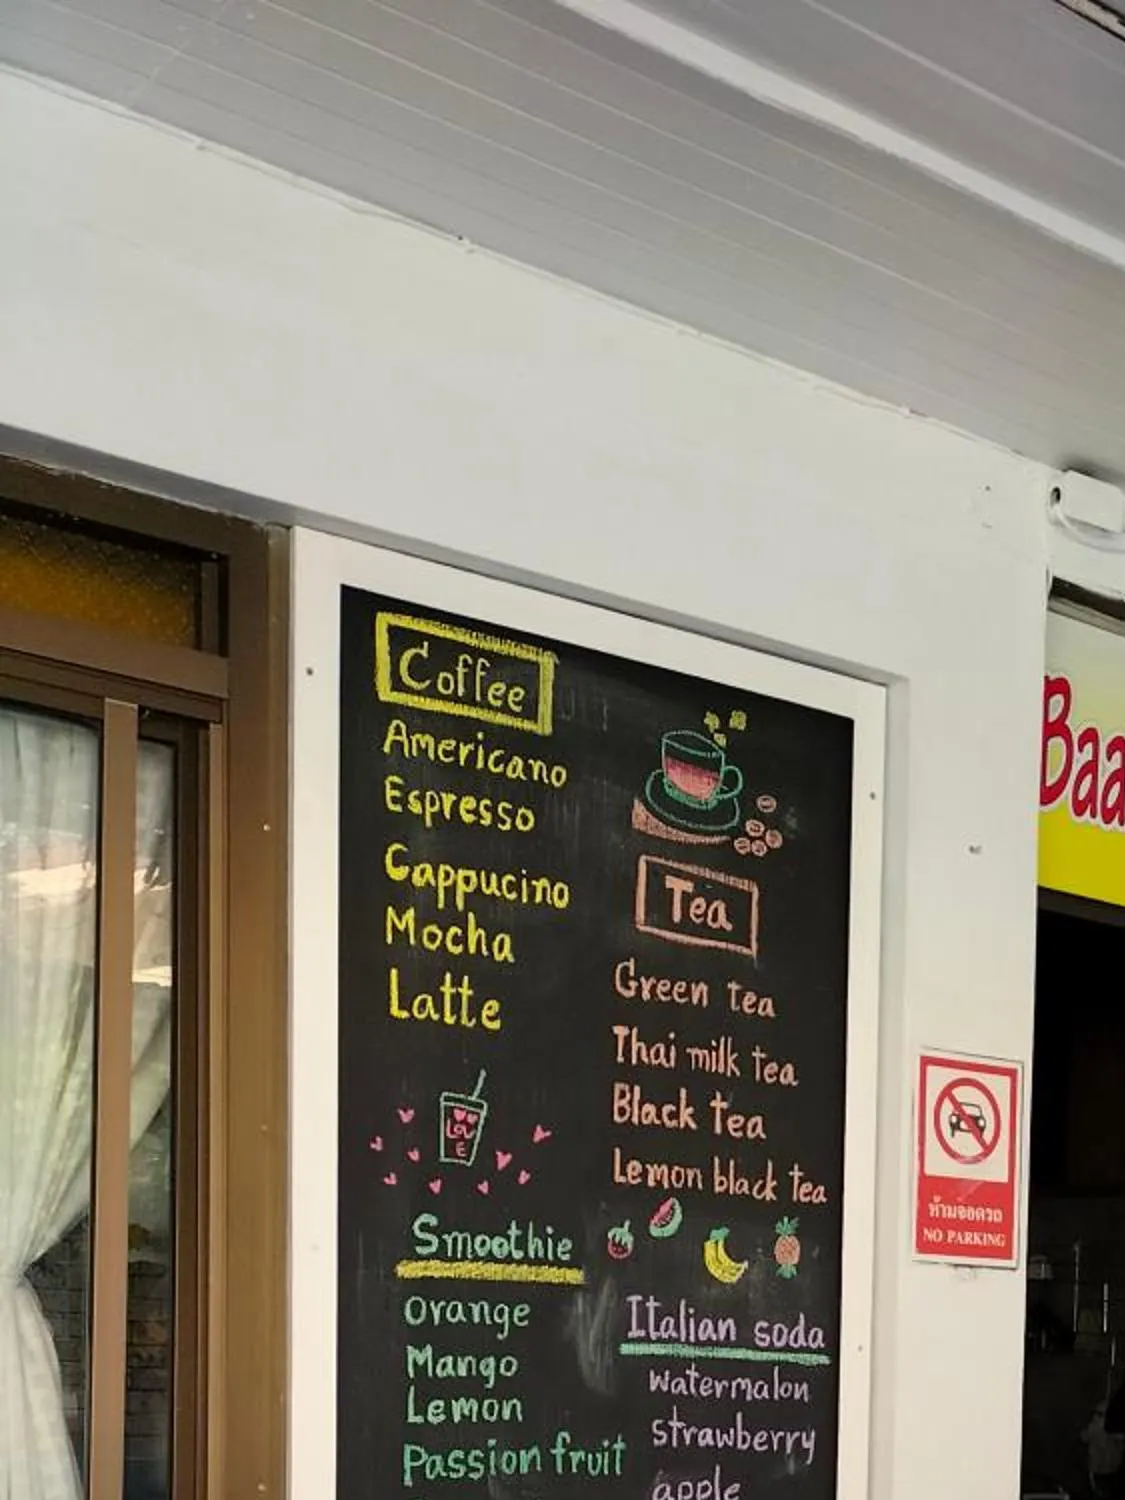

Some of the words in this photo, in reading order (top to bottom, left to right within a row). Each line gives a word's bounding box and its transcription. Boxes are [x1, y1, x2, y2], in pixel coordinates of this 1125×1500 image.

[400, 641, 526, 713] Coffee
[383, 718, 568, 788] Americano
[384, 776, 536, 833] Espresso
[385, 842, 570, 909] Cappucino
[665, 874, 733, 933] Tea
[385, 905, 515, 964] Mocha
[389, 967, 501, 1031] Latte
[613, 958, 709, 1008] Green
[727, 980, 776, 1018] tea
[613, 1025, 676, 1070] Thai
[686, 1037, 740, 1078] milk
[751, 1044, 798, 1086] tea
[611, 1083, 698, 1131] Black
[710, 1096, 767, 1140] tea
[611, 1147, 702, 1190] Lemon
[712, 1158, 777, 1202] black
[789, 1164, 828, 1204] tea
[412, 1214, 573, 1261] Smoothie
[923, 1227, 943, 1242] NO
[946, 1229, 1006, 1247] PARKING
[405, 1296, 531, 1340] Orange
[626, 1295, 737, 1343] Italian
[754, 1313, 826, 1350] soda
[406, 1344, 519, 1388] Mango
[407, 1384, 523, 1425] Lemon
[403, 1438, 542, 1488] Passion
[550, 1431, 627, 1478] fruit
[651, 1405, 816, 1464] strawberry
